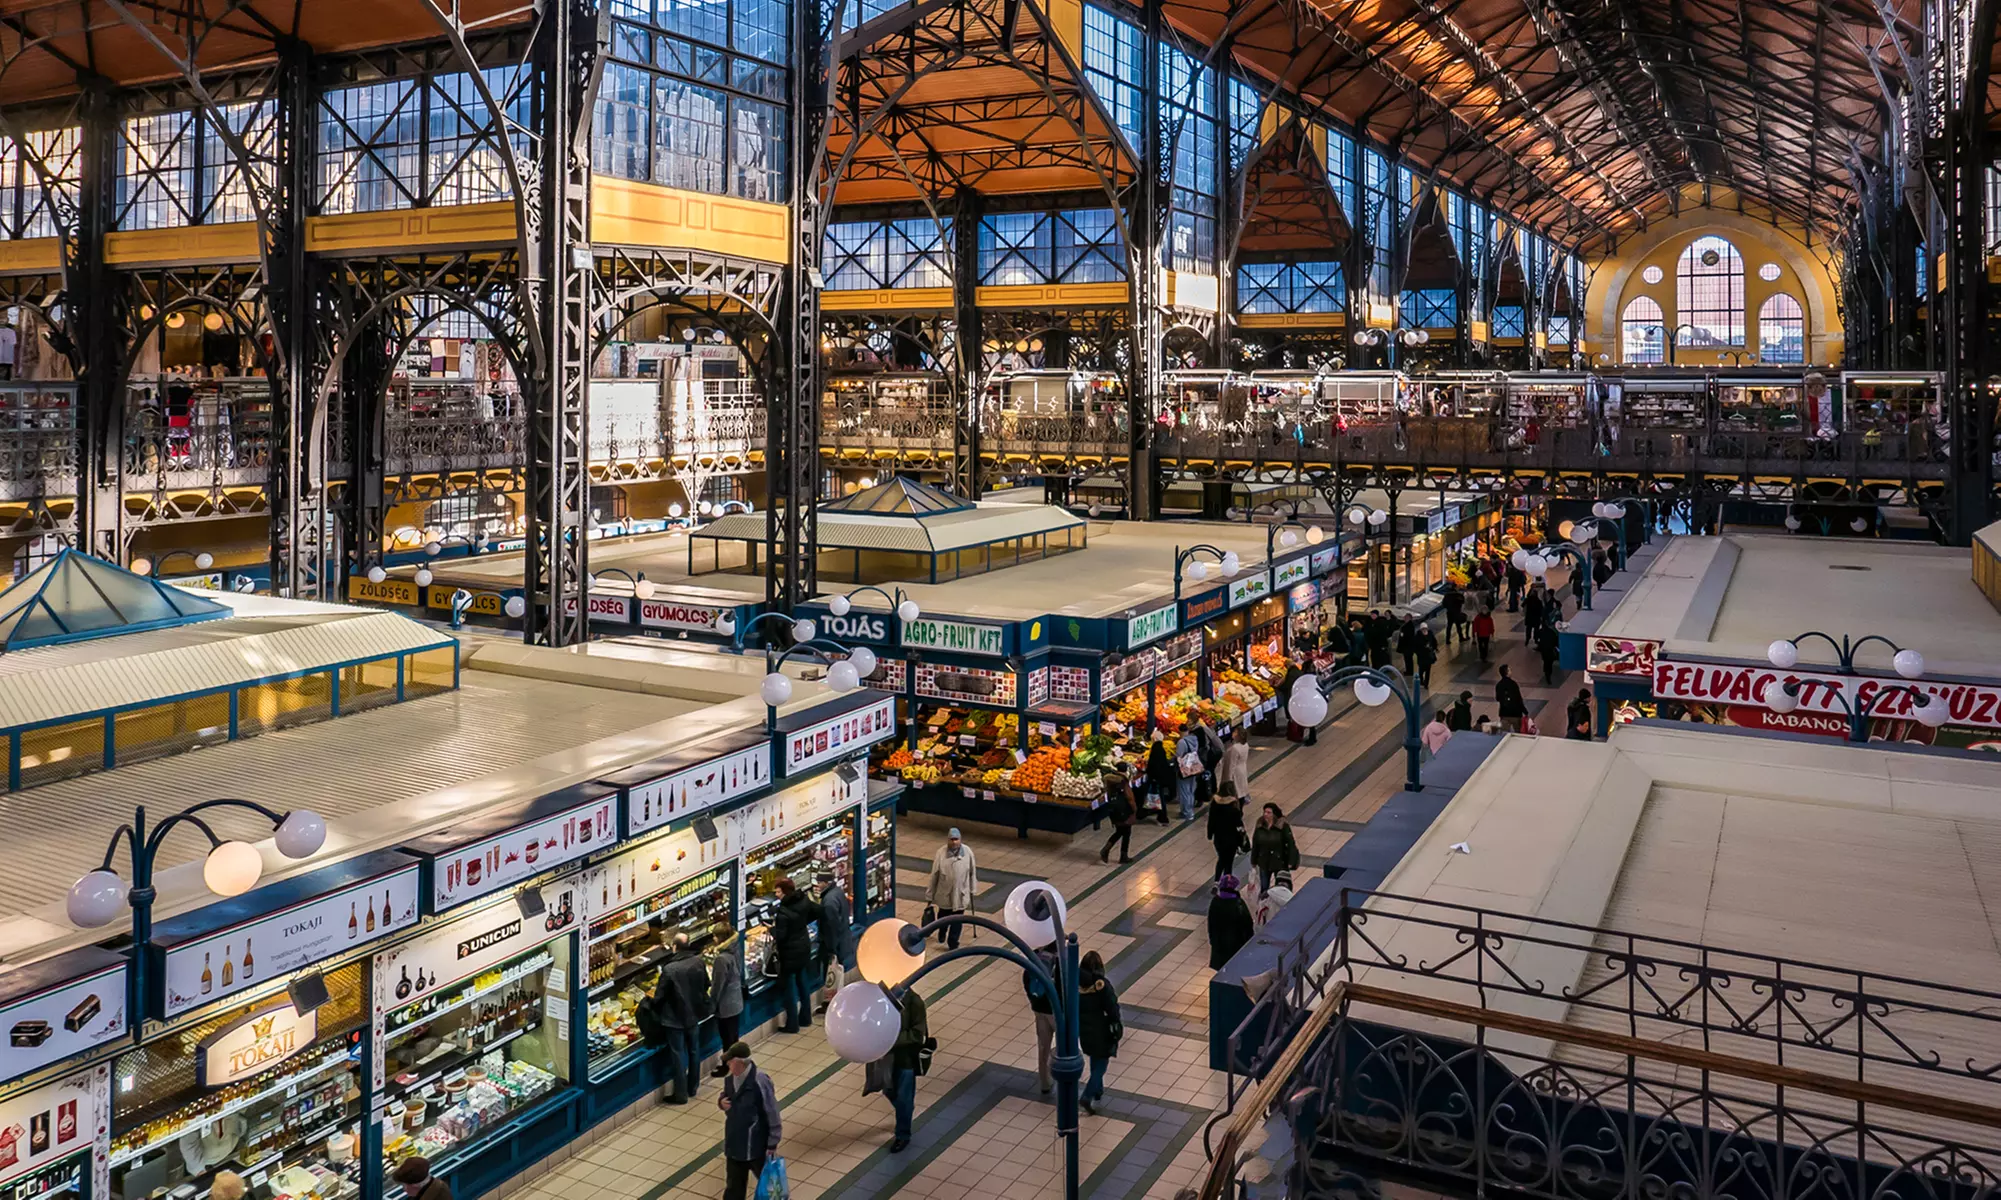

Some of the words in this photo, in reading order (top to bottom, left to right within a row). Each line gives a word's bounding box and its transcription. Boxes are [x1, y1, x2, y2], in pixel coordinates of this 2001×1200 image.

[360, 582, 409, 600] ZÖLDSÉG
[434, 591, 496, 610] GYLCS
[642, 604, 709, 624] GYÜMÖLCS
[821, 614, 885, 640] TOJÁS
[1656, 664, 1844, 709] FELVÁGTT
[1762, 712, 1852, 732] KABANOS
[283, 915, 323, 938] TOKAJI
[470, 922, 521, 951] UNICUM
[229, 1030, 296, 1074] TOKAJI
